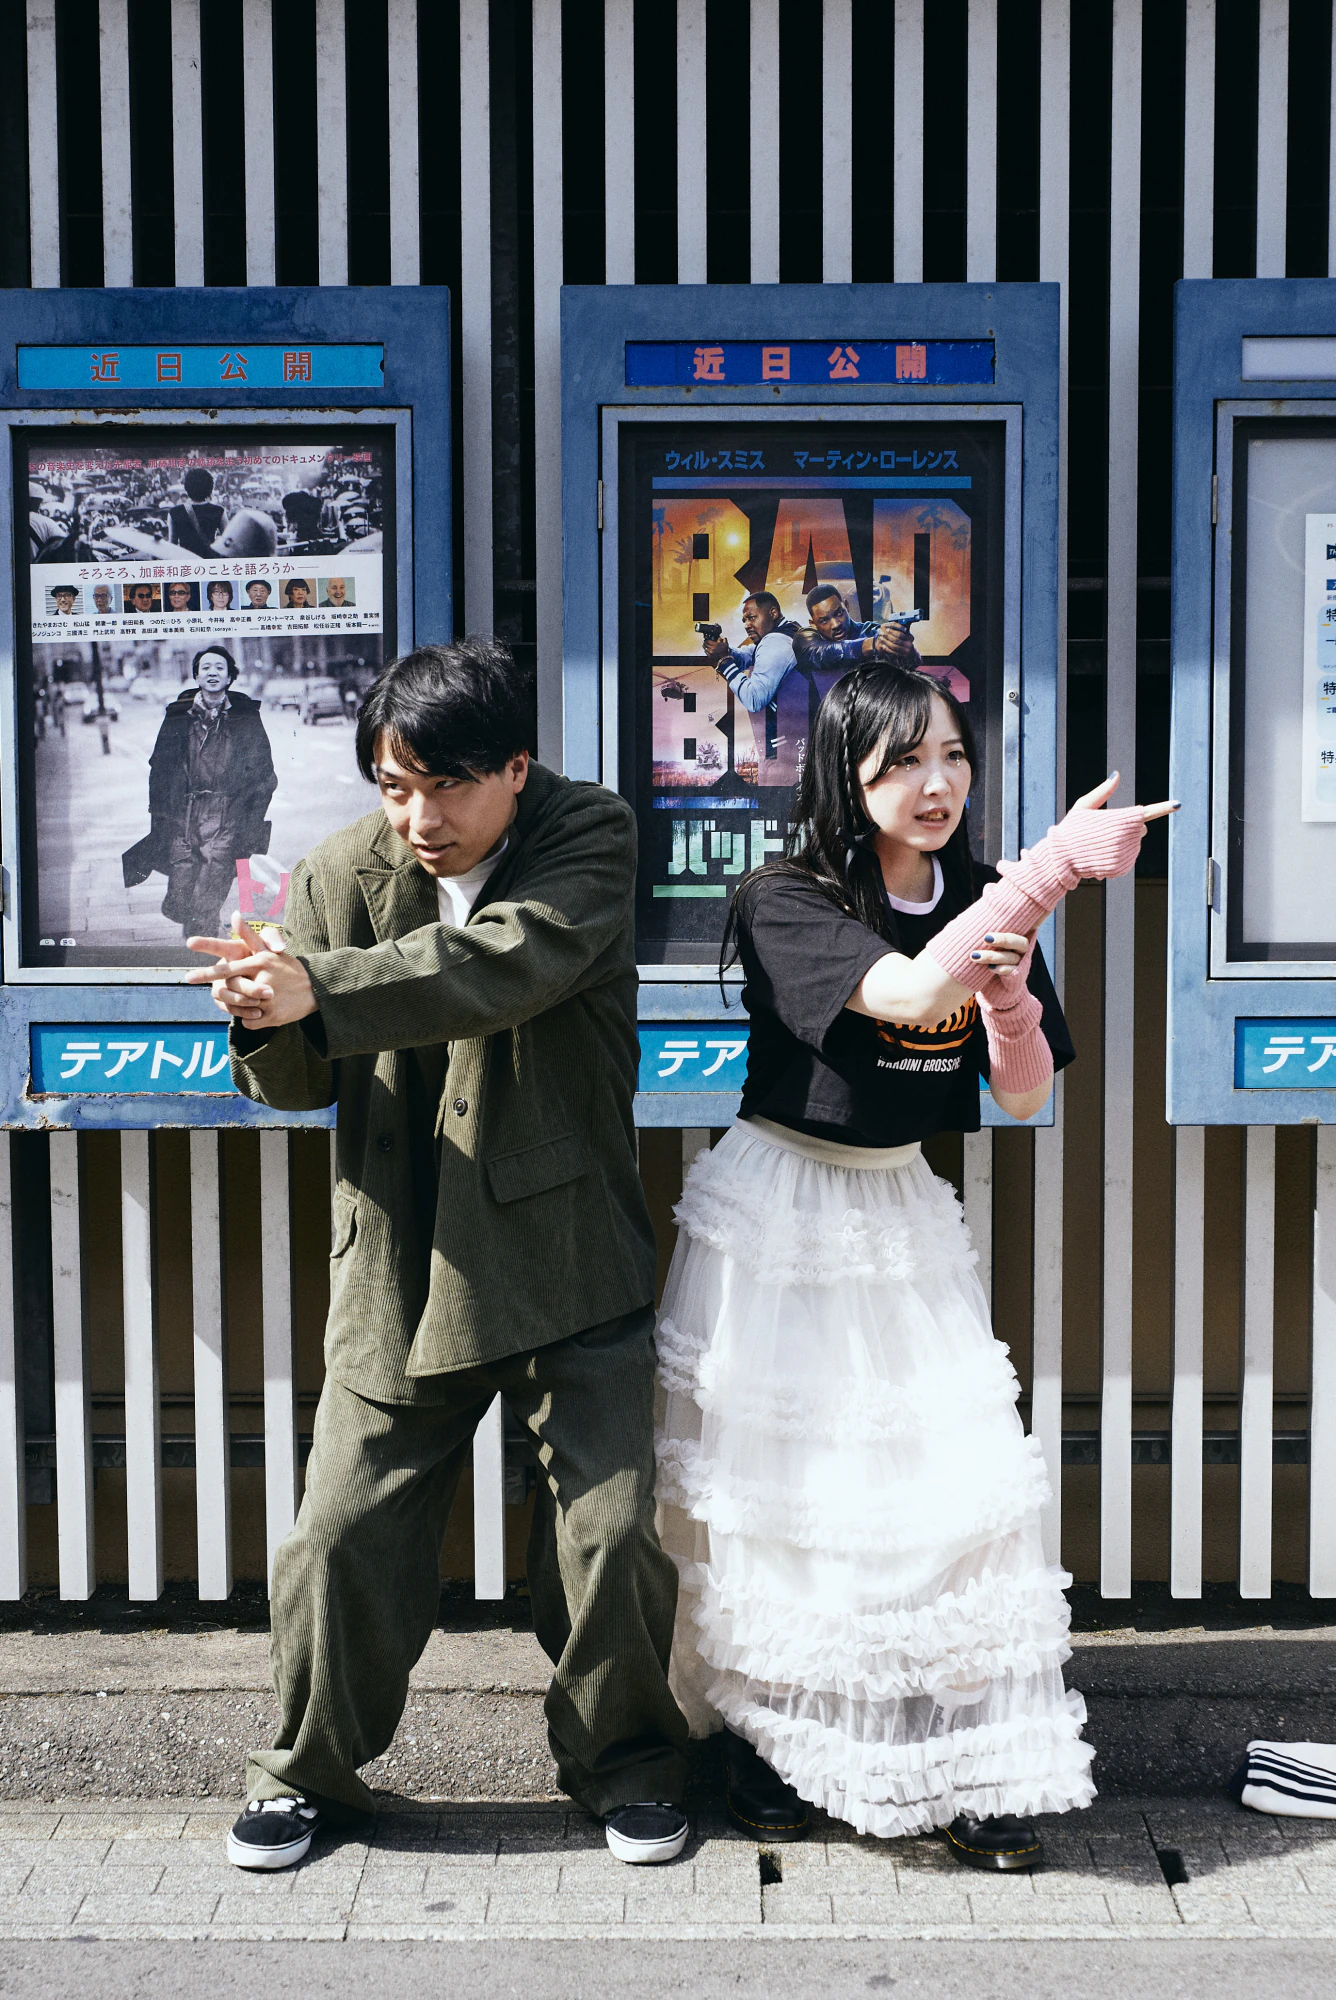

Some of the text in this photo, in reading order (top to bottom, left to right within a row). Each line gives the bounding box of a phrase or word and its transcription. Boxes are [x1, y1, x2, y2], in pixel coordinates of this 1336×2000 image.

[90, 351, 313, 383] 近日公開
[693, 345, 927, 381] 近日公開
[665, 450, 959, 471] ウィル・スミス マーティン・ローレンス
[652, 499, 971, 657] BAD
[60, 1040, 230, 1079] テアトル
